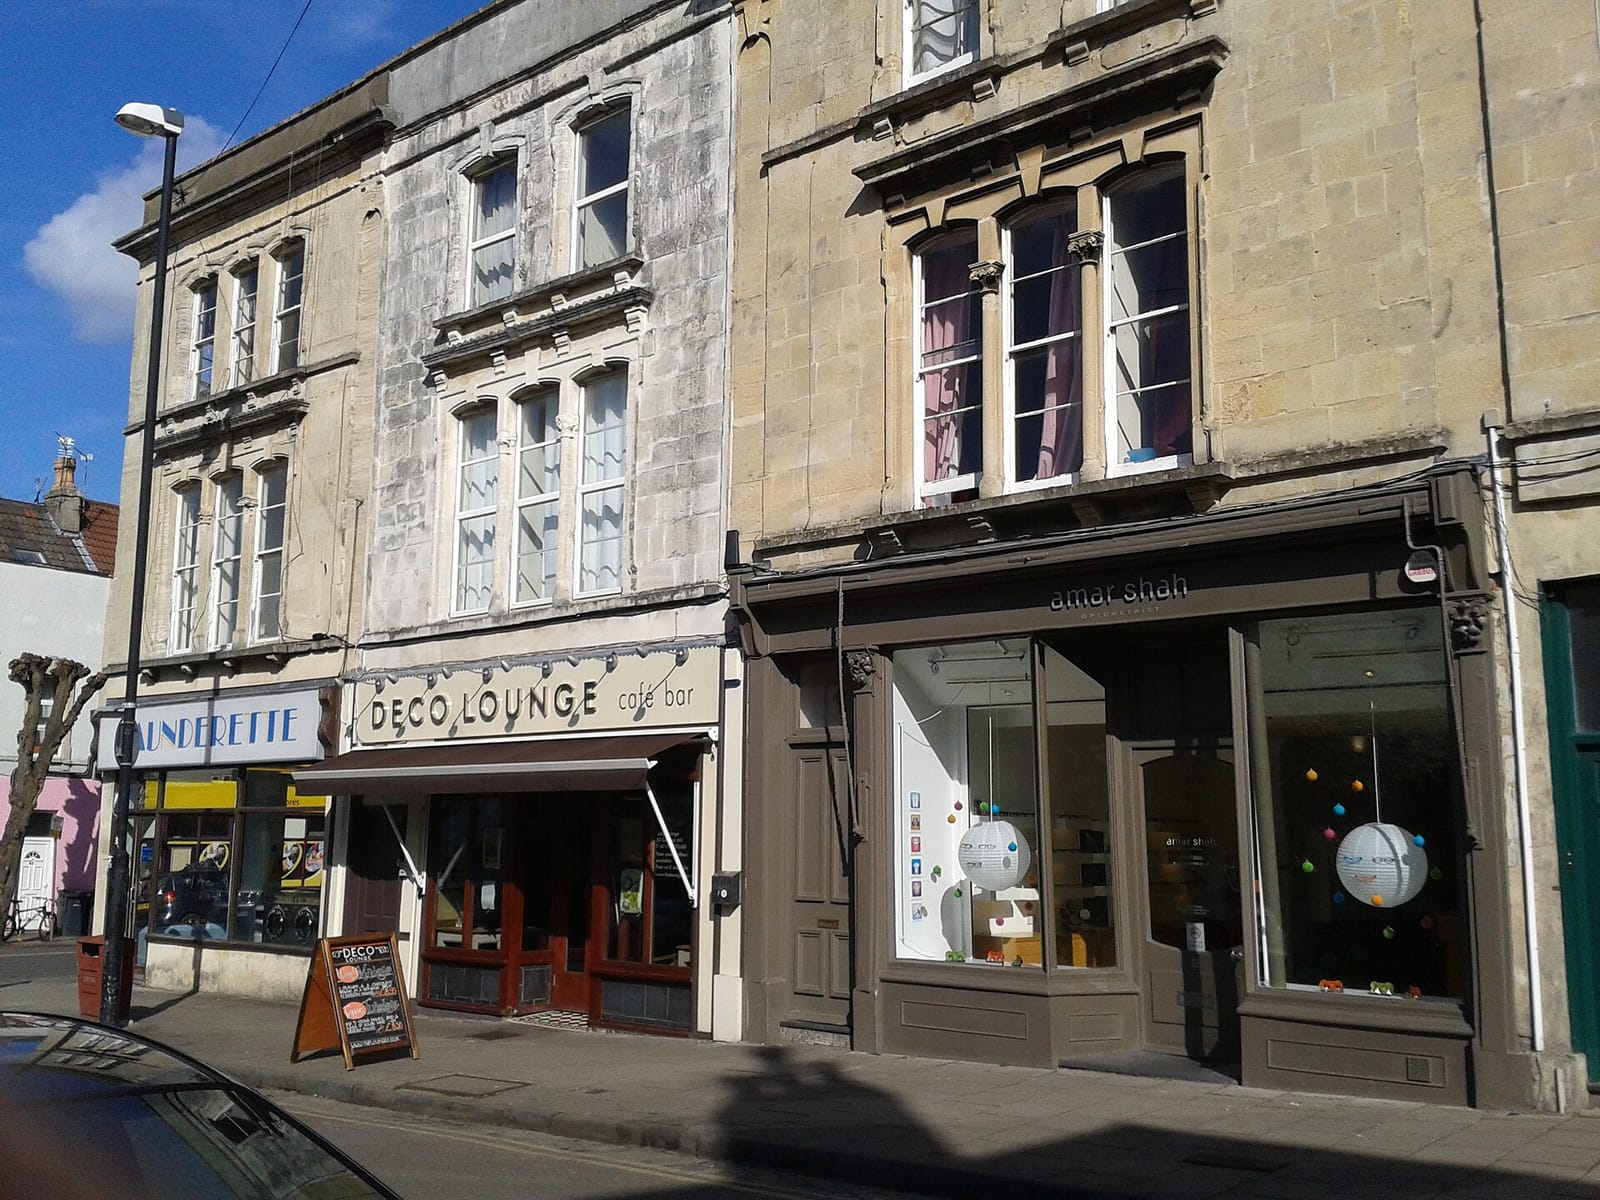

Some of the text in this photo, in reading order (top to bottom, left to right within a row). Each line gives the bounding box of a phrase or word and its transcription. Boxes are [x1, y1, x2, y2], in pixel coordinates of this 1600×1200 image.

[1050, 572, 1188, 611] amar shah
[371, 679, 694, 730] DECO LOUNGE café bar
[135, 706, 299, 753] AUNDERETTE
[342, 946, 375, 958] DECO
